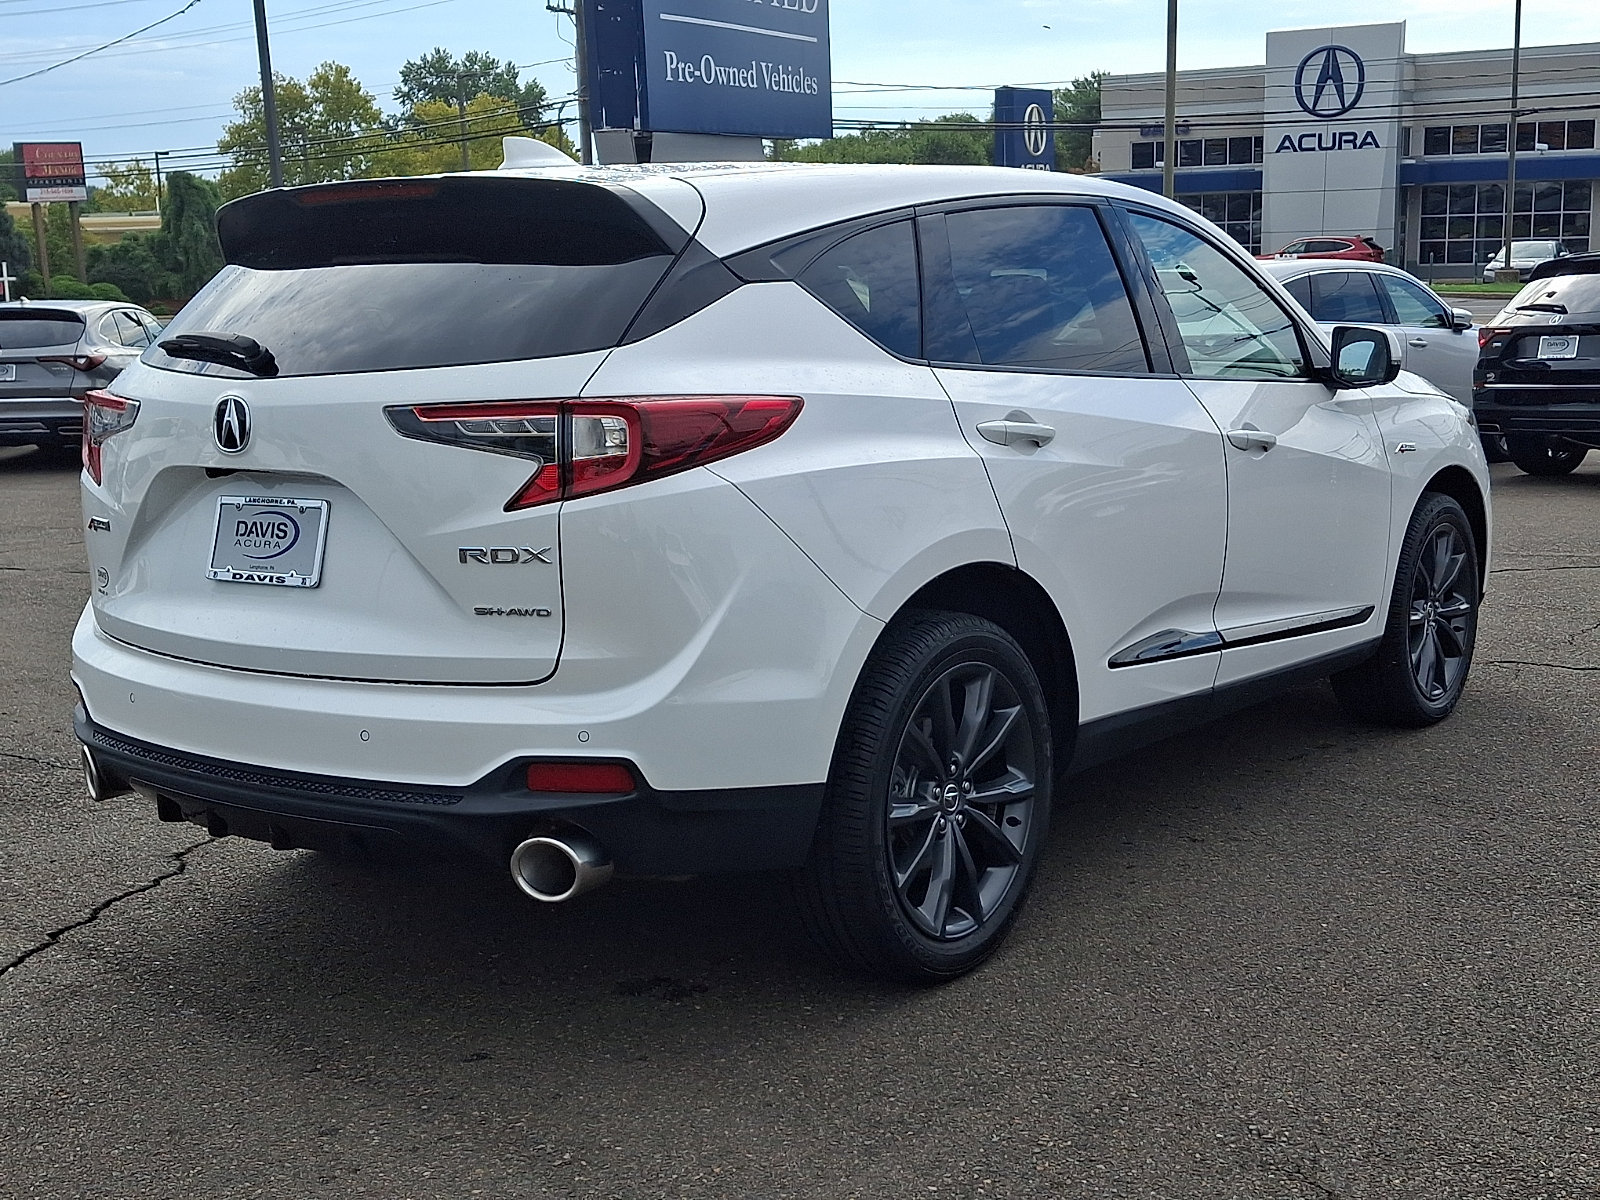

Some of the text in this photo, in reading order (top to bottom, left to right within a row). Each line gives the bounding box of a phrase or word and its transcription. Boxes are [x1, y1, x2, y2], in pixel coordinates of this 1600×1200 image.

[664, 51, 818, 95] Pre-Owned Vehicles
[1275, 130, 1381, 154] ACURA
[235, 520, 289, 540] DAVIS
[233, 539, 281, 549] ACURA
[458, 546, 553, 565] RDX
[231, 573, 287, 583] DAVIS
[473, 606, 552, 618] SH-AWD
